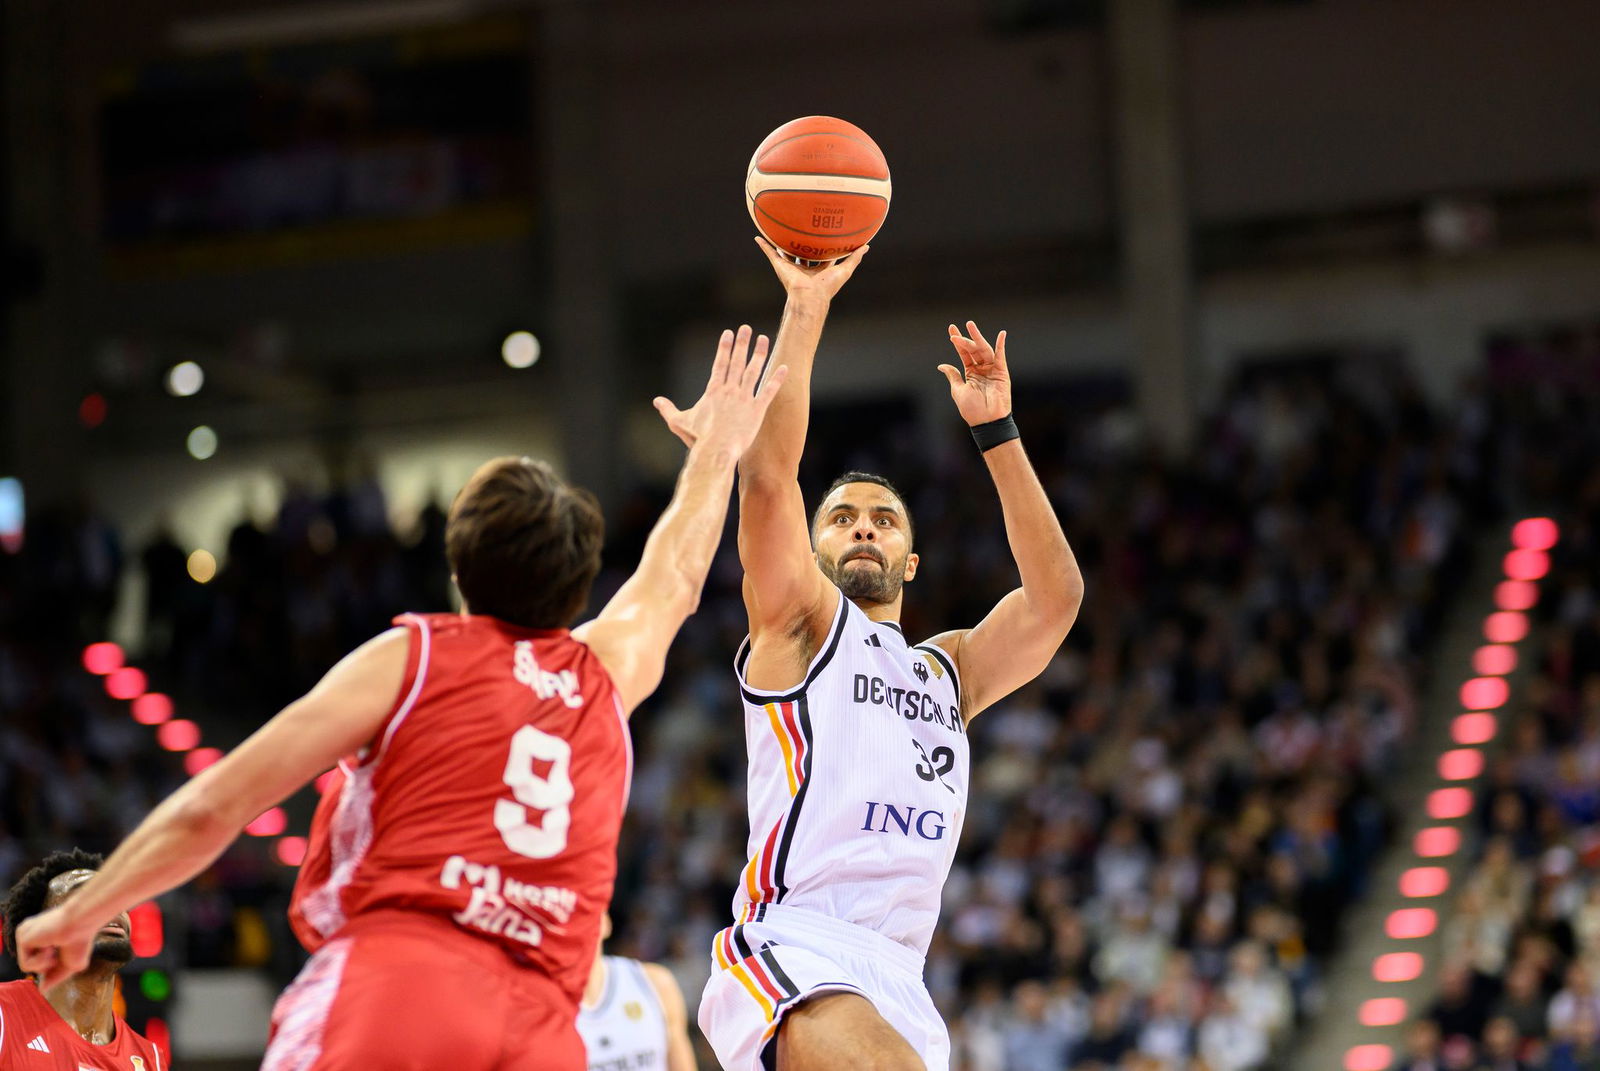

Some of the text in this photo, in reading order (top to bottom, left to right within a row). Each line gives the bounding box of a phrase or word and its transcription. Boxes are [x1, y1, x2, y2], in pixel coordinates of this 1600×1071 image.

[811, 214, 843, 229] FIBA
[789, 240, 854, 256] molten
[853, 674, 963, 735] DEUTSCHLA
[911, 738, 956, 794] 32
[493, 723, 575, 859] 9
[860, 801, 947, 841] ING
